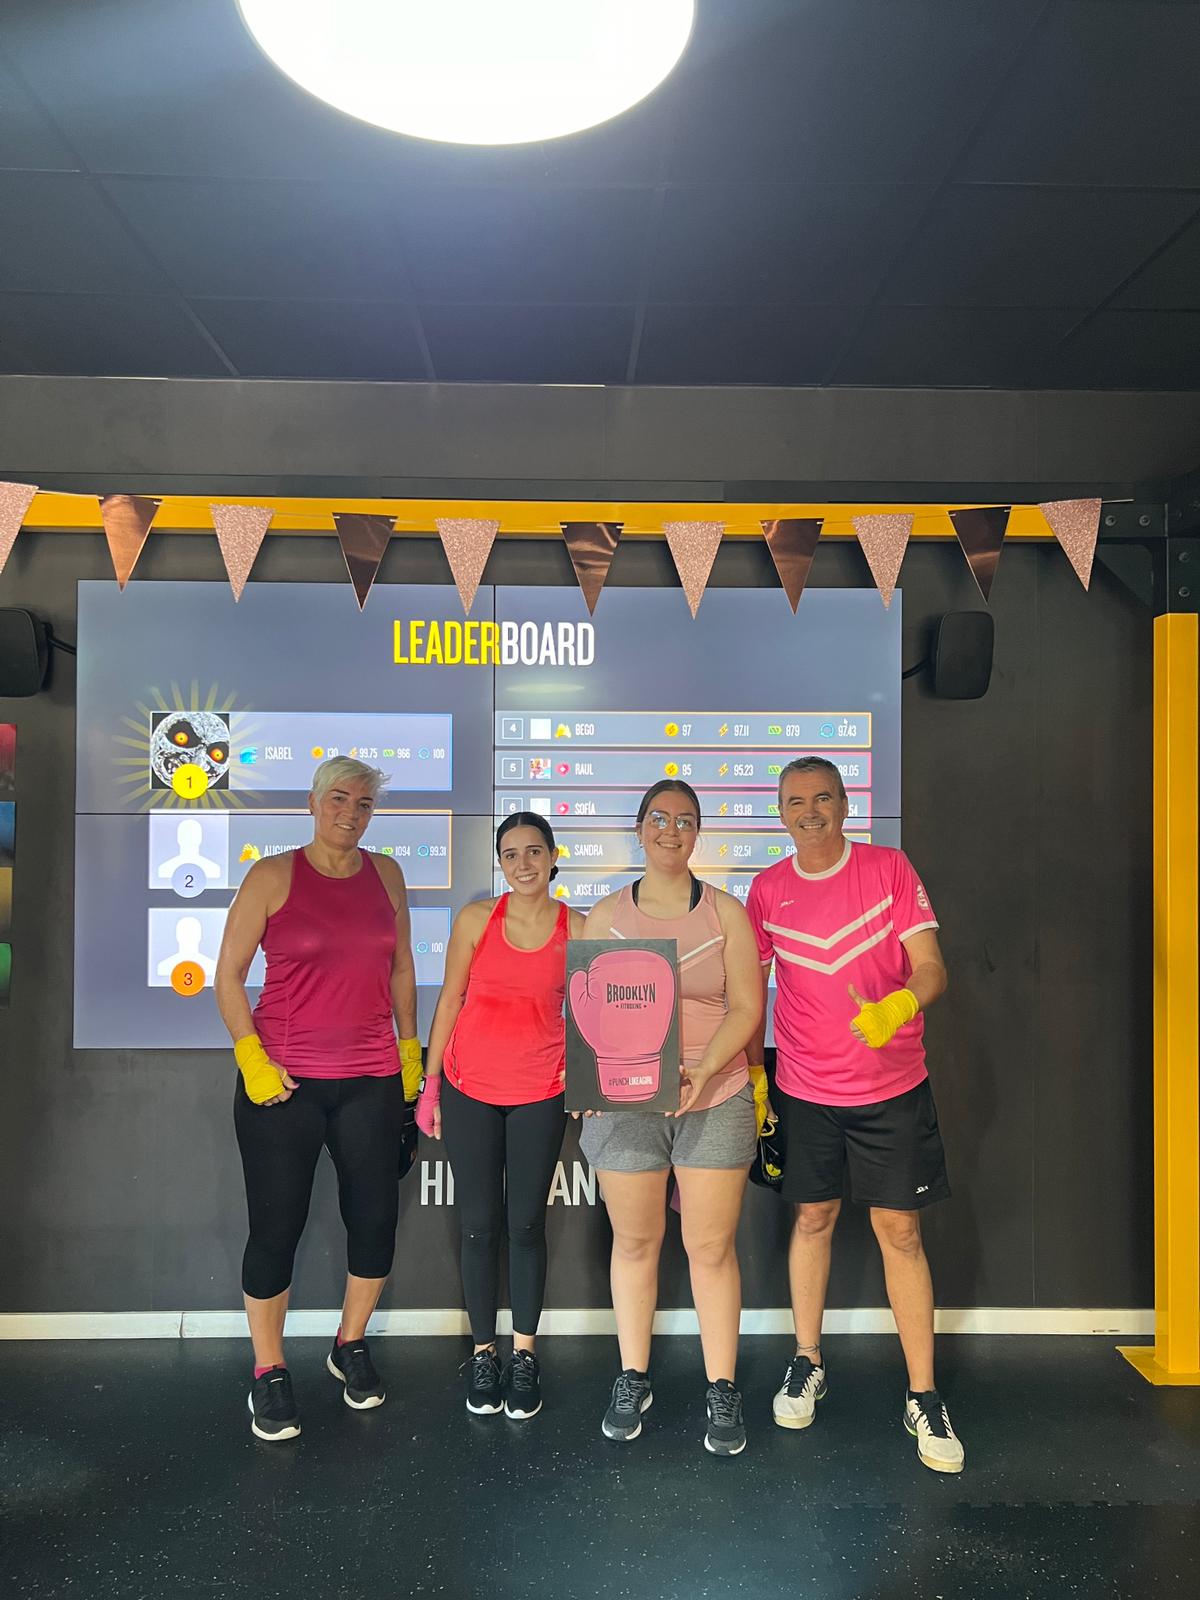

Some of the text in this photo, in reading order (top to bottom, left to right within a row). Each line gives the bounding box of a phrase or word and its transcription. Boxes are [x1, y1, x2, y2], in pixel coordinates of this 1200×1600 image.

[393, 620, 595, 666] LEADERBOARD
[510, 723, 516, 733] 4
[575, 724, 595, 736] BEGO
[682, 724, 692, 736] 97
[785, 725, 800, 737] 879
[185, 776, 193, 788] 1
[265, 746, 293, 760] ISABEL
[359, 748, 378, 759] 99.75
[433, 748, 445, 759] 100
[510, 763, 516, 772] 5
[575, 763, 594, 775] RAUL
[682, 764, 692, 776] 95
[734, 764, 754, 776] 95.23
[509, 803, 516, 812] 6
[574, 844, 603, 857] SANDRA
[185, 875, 194, 888] 2
[395, 845, 411, 857] 1094
[574, 883, 593, 896] JOSE
[594, 884, 610, 897] LUIS
[184, 942, 443, 986] 3 100
[607, 982, 656, 1003] BROOKLYN
